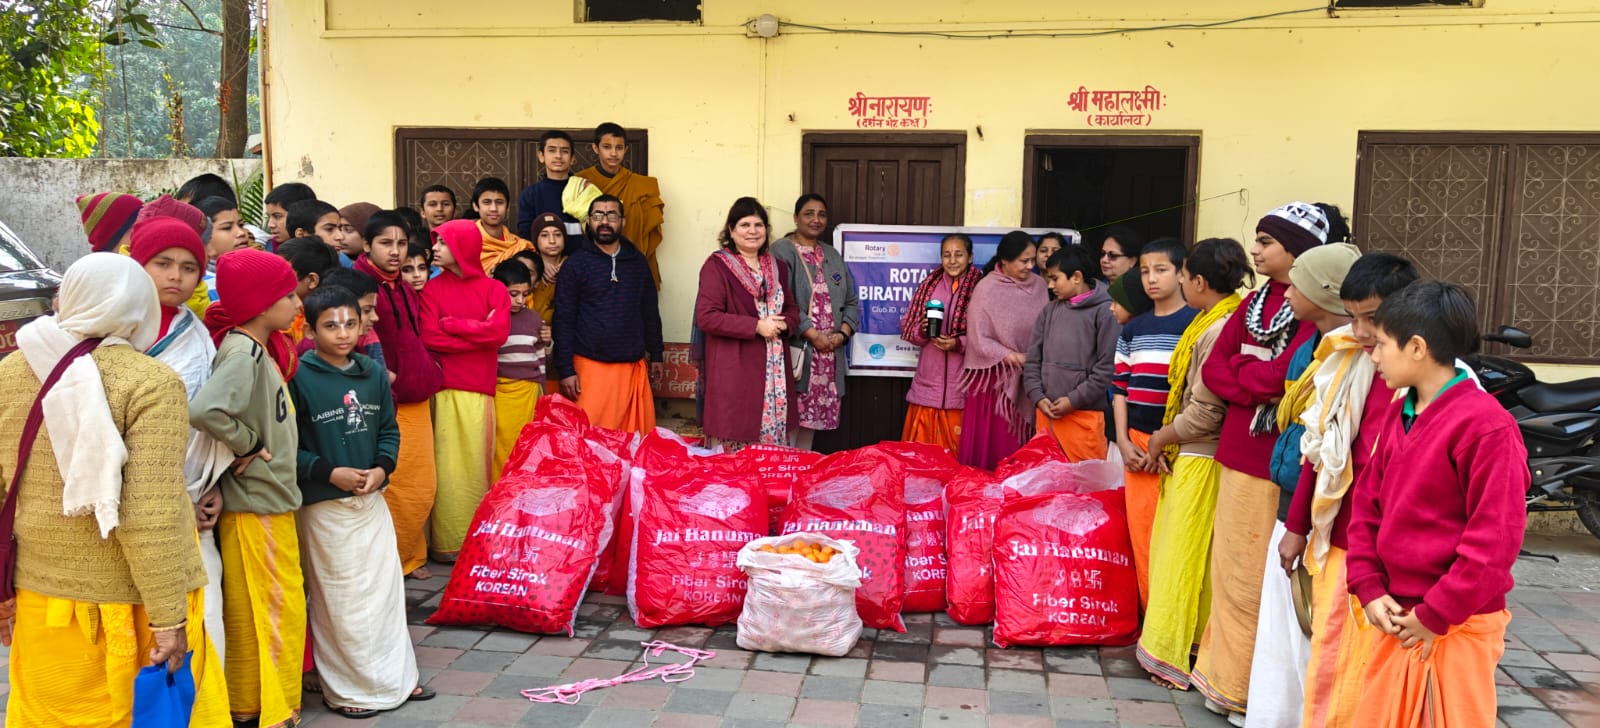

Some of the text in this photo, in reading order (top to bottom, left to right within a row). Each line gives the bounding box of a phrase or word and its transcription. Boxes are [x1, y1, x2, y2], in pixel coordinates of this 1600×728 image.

[865, 244, 886, 252] Rotary
[890, 268, 930, 284] ROTA
[859, 286, 918, 302] BIRATN
[806, 517, 897, 537] Hanuman
[473, 519, 587, 552] Jai Hanuman
[653, 527, 767, 546] Jai Hanuma
[905, 554, 934, 568] iber
[1009, 540, 1129, 568] Jai Hanuman
[470, 564, 506, 580] Fiber
[912, 568, 946, 581] KORE
[475, 580, 529, 597] KOREAN
[671, 573, 710, 588] Fiber
[684, 590, 741, 604] KOREAN
[1032, 592, 1076, 609] Fiber
[1048, 611, 1107, 627] KOREAN
